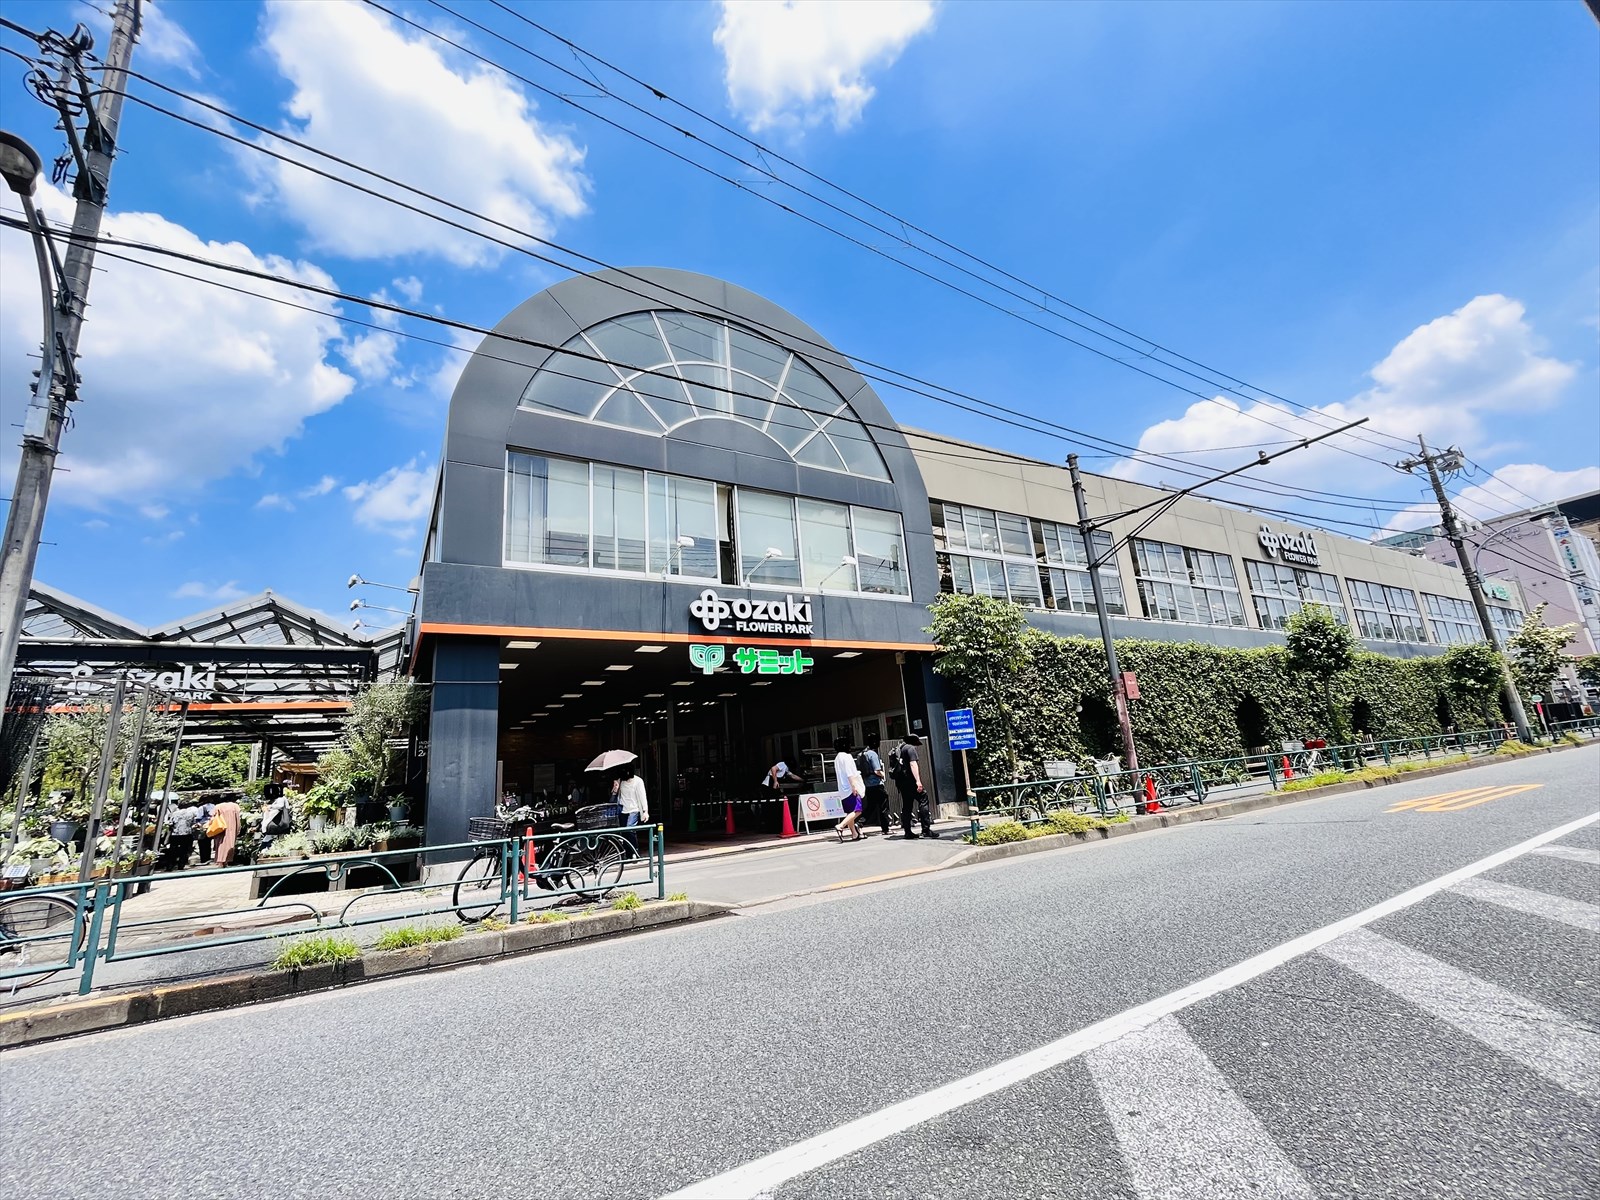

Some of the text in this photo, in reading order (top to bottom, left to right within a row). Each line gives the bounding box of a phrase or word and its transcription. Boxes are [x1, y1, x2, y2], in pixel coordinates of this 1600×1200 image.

[1277, 531, 1318, 556] ozaki
[732, 594, 812, 623] ozaki
[736, 621, 814, 635] FLOWER PARK
[733, 647, 814, 675] サミット
